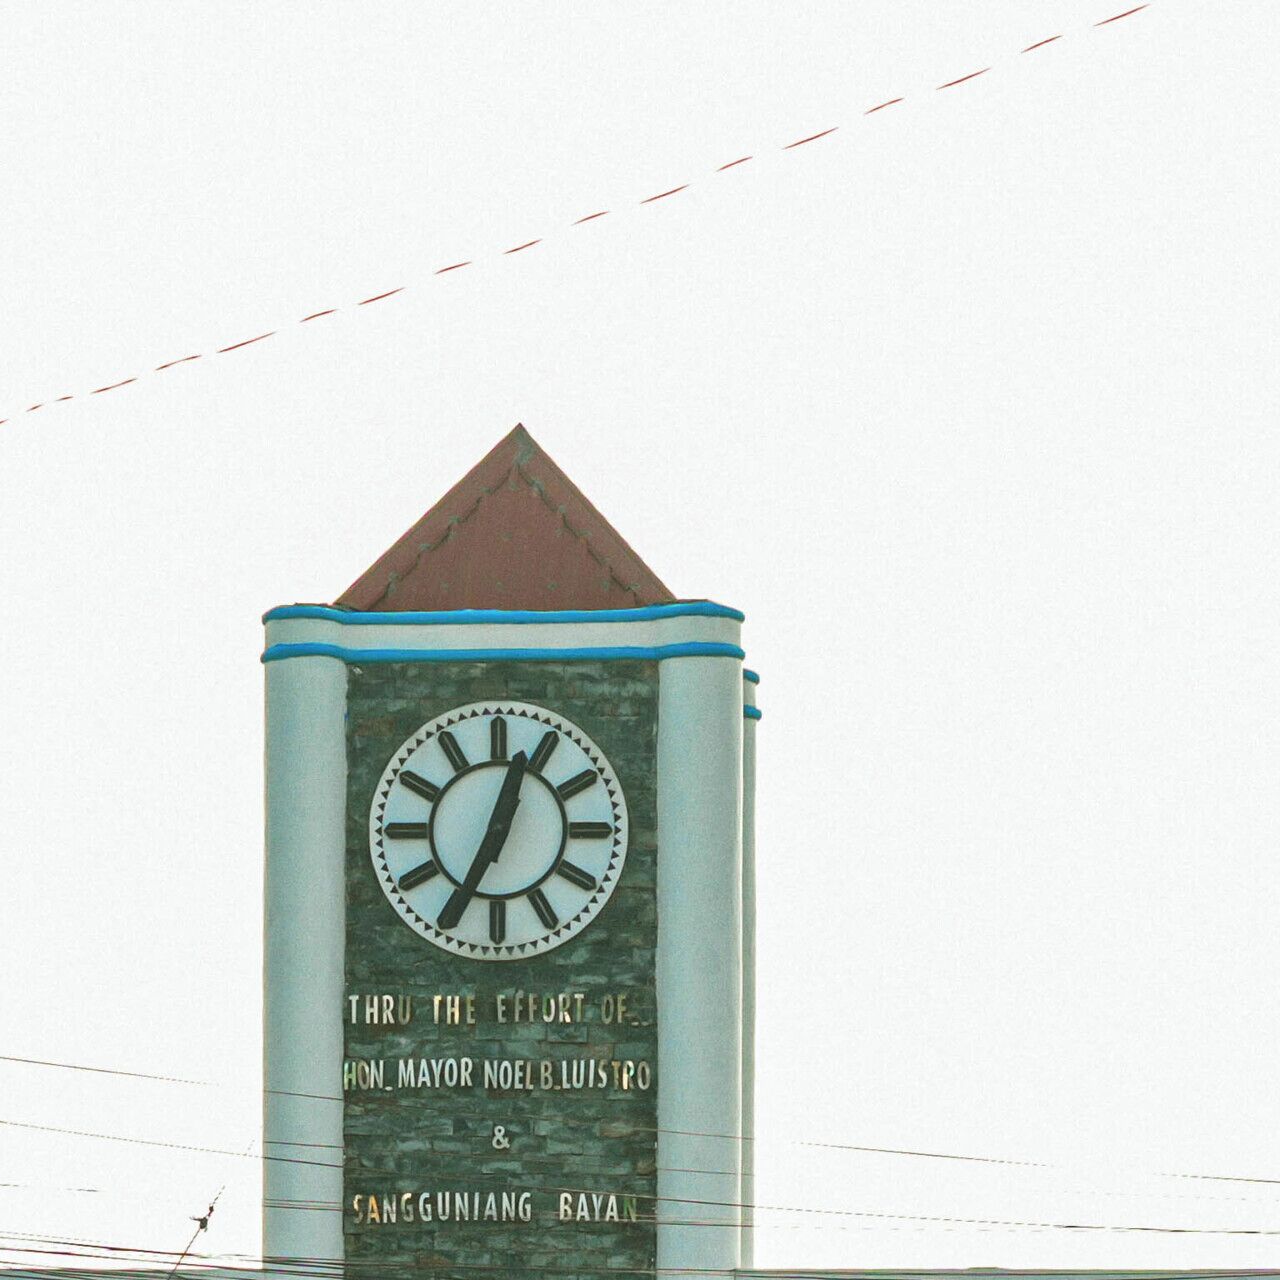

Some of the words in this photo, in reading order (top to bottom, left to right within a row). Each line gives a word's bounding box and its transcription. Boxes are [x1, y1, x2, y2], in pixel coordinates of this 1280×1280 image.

[348, 994, 412, 1025] THRU
[432, 994, 476, 1025] THE
[496, 993, 585, 1024] EFFORT
[344, 1060, 393, 1091] HON.
[397, 1058, 473, 1089] MAYOR
[484, 1060, 534, 1090] NOEL
[562, 1059, 651, 1090] LUISTRO
[491, 1125, 510, 1150] &
[352, 1192, 532, 1224] SANGGUNIANG
[559, 1192, 638, 1222] BAYAN
